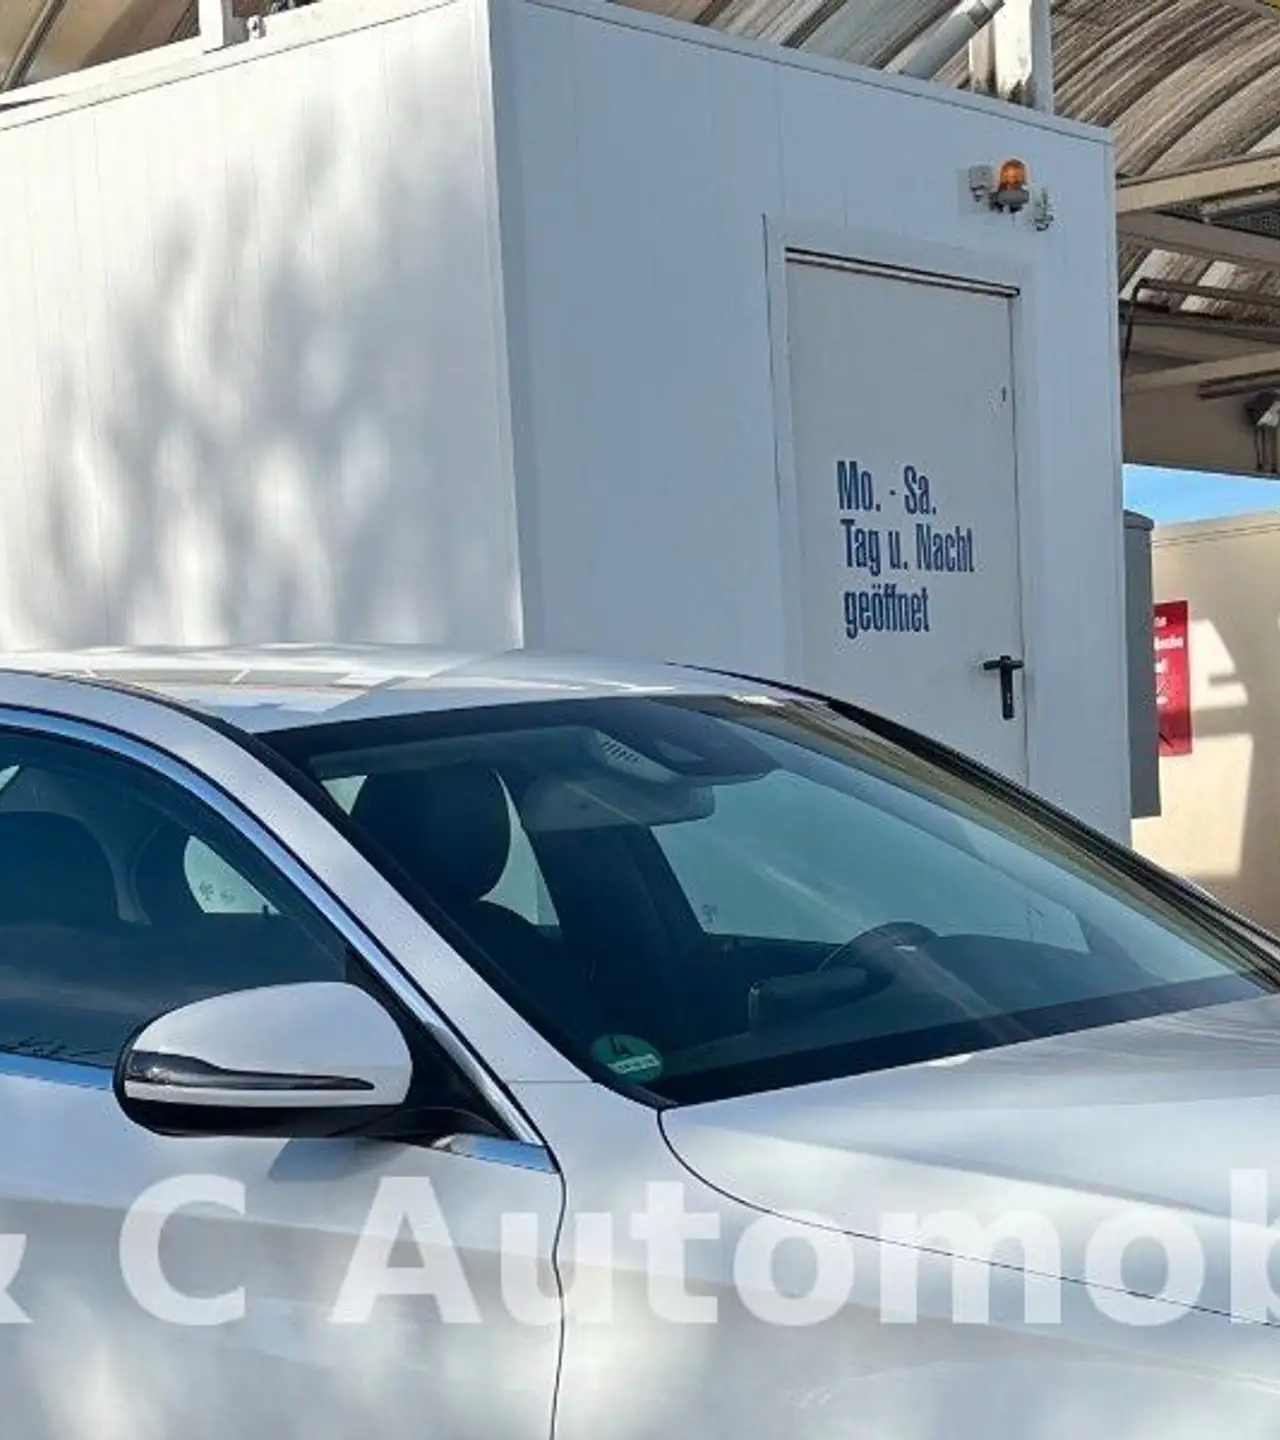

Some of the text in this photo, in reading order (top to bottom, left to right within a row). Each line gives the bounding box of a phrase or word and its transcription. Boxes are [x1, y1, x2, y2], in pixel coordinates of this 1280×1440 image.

[836, 460, 881, 513] Mo.
[902, 464, 937, 516] Sa.
[839, 517, 976, 577] Tag u. Nacht
[843, 583, 931, 640] geöffnet
